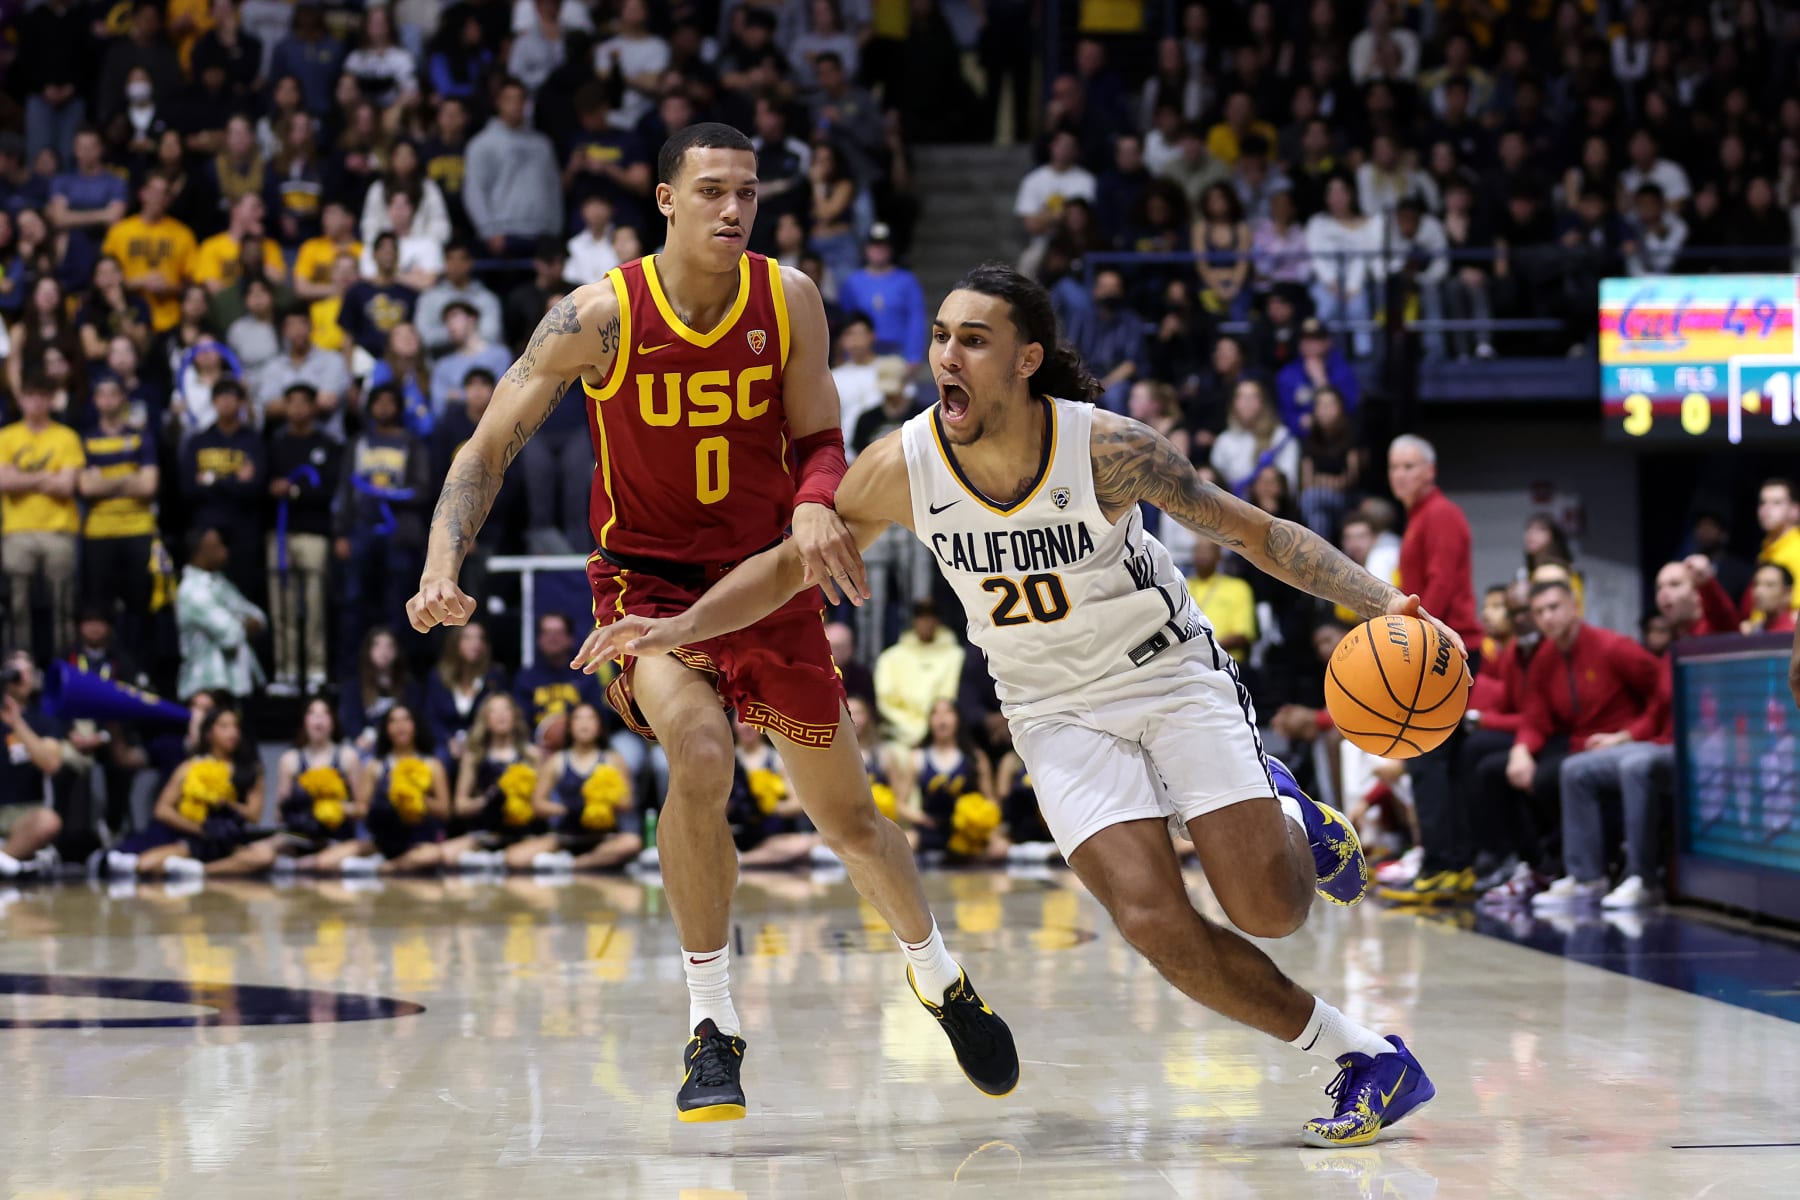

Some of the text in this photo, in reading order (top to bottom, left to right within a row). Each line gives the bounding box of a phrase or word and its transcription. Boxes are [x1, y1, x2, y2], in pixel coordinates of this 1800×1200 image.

[1722, 296, 1777, 339] 49
[636, 364, 774, 427] USC
[1622, 392, 1654, 437] 3
[1680, 391, 1712, 436] 0
[695, 435, 730, 504] 0
[931, 521, 1095, 574] CALIFORNIA
[979, 571, 1072, 627] 20
[1384, 616, 1409, 647] EVO
